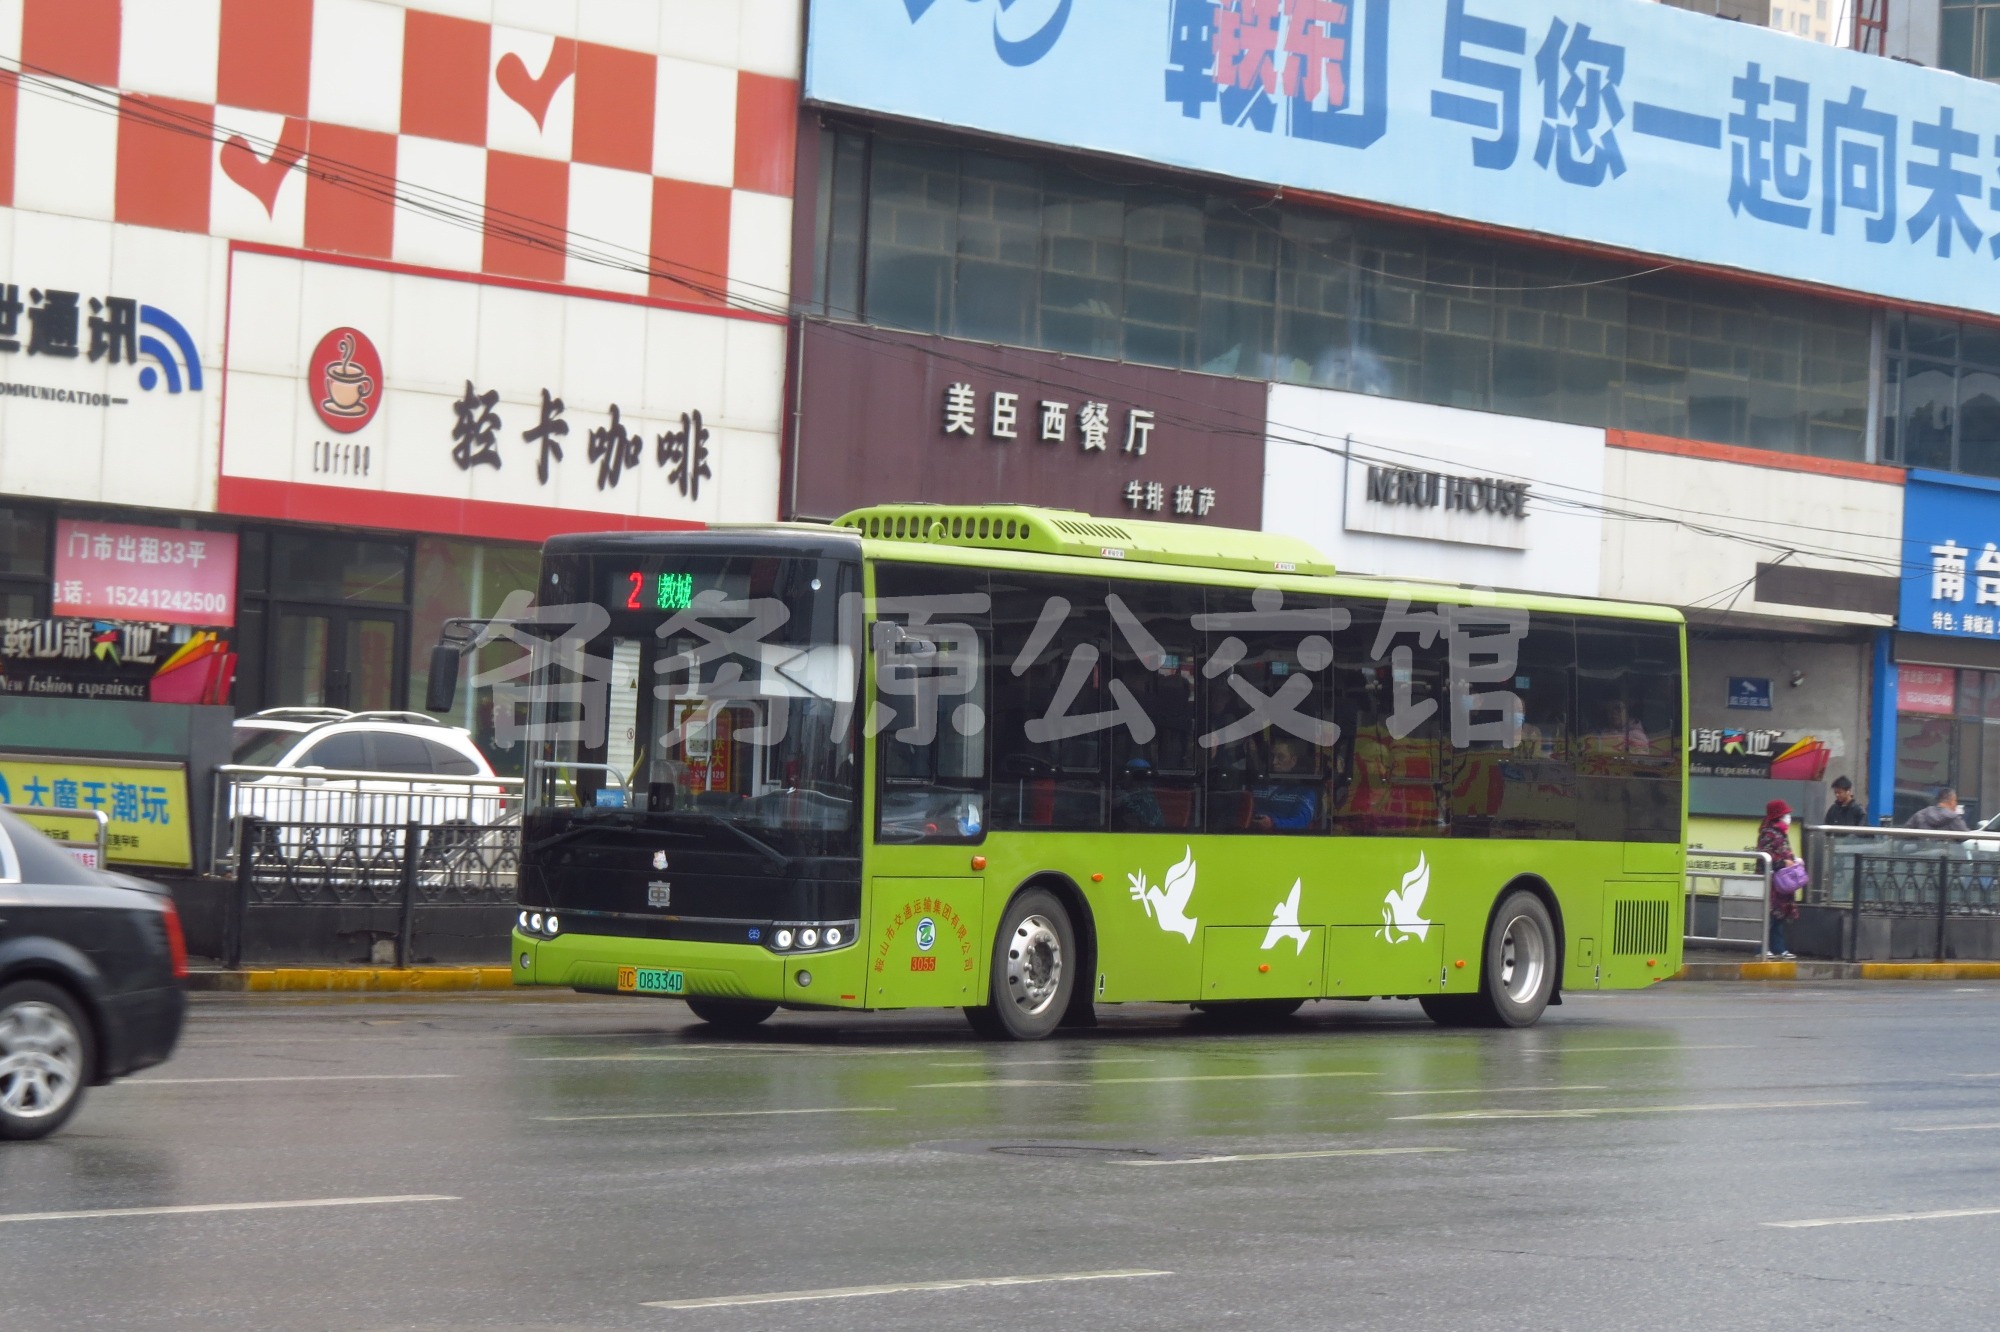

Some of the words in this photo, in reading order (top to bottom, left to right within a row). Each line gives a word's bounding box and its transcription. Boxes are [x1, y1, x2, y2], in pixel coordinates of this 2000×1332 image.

[1430, 0, 2000, 262] 与您一起向未
[945, 382, 1155, 456] 美臣西餐厅
[452, 379, 712, 502] 轻卡咖啡
[1125, 479, 1164, 511] 牛排
[1175, 484, 1216, 516] 披萨
[1446, 474, 1532, 519] HOUSE
[68, 531, 207, 568] 门市出租33平
[627, 572, 643, 608] 2
[657, 573, 692, 609] 教城
[874, 896, 974, 973] 鞍山市交通运输集团有限公司
[912, 957, 935, 971] 3055
